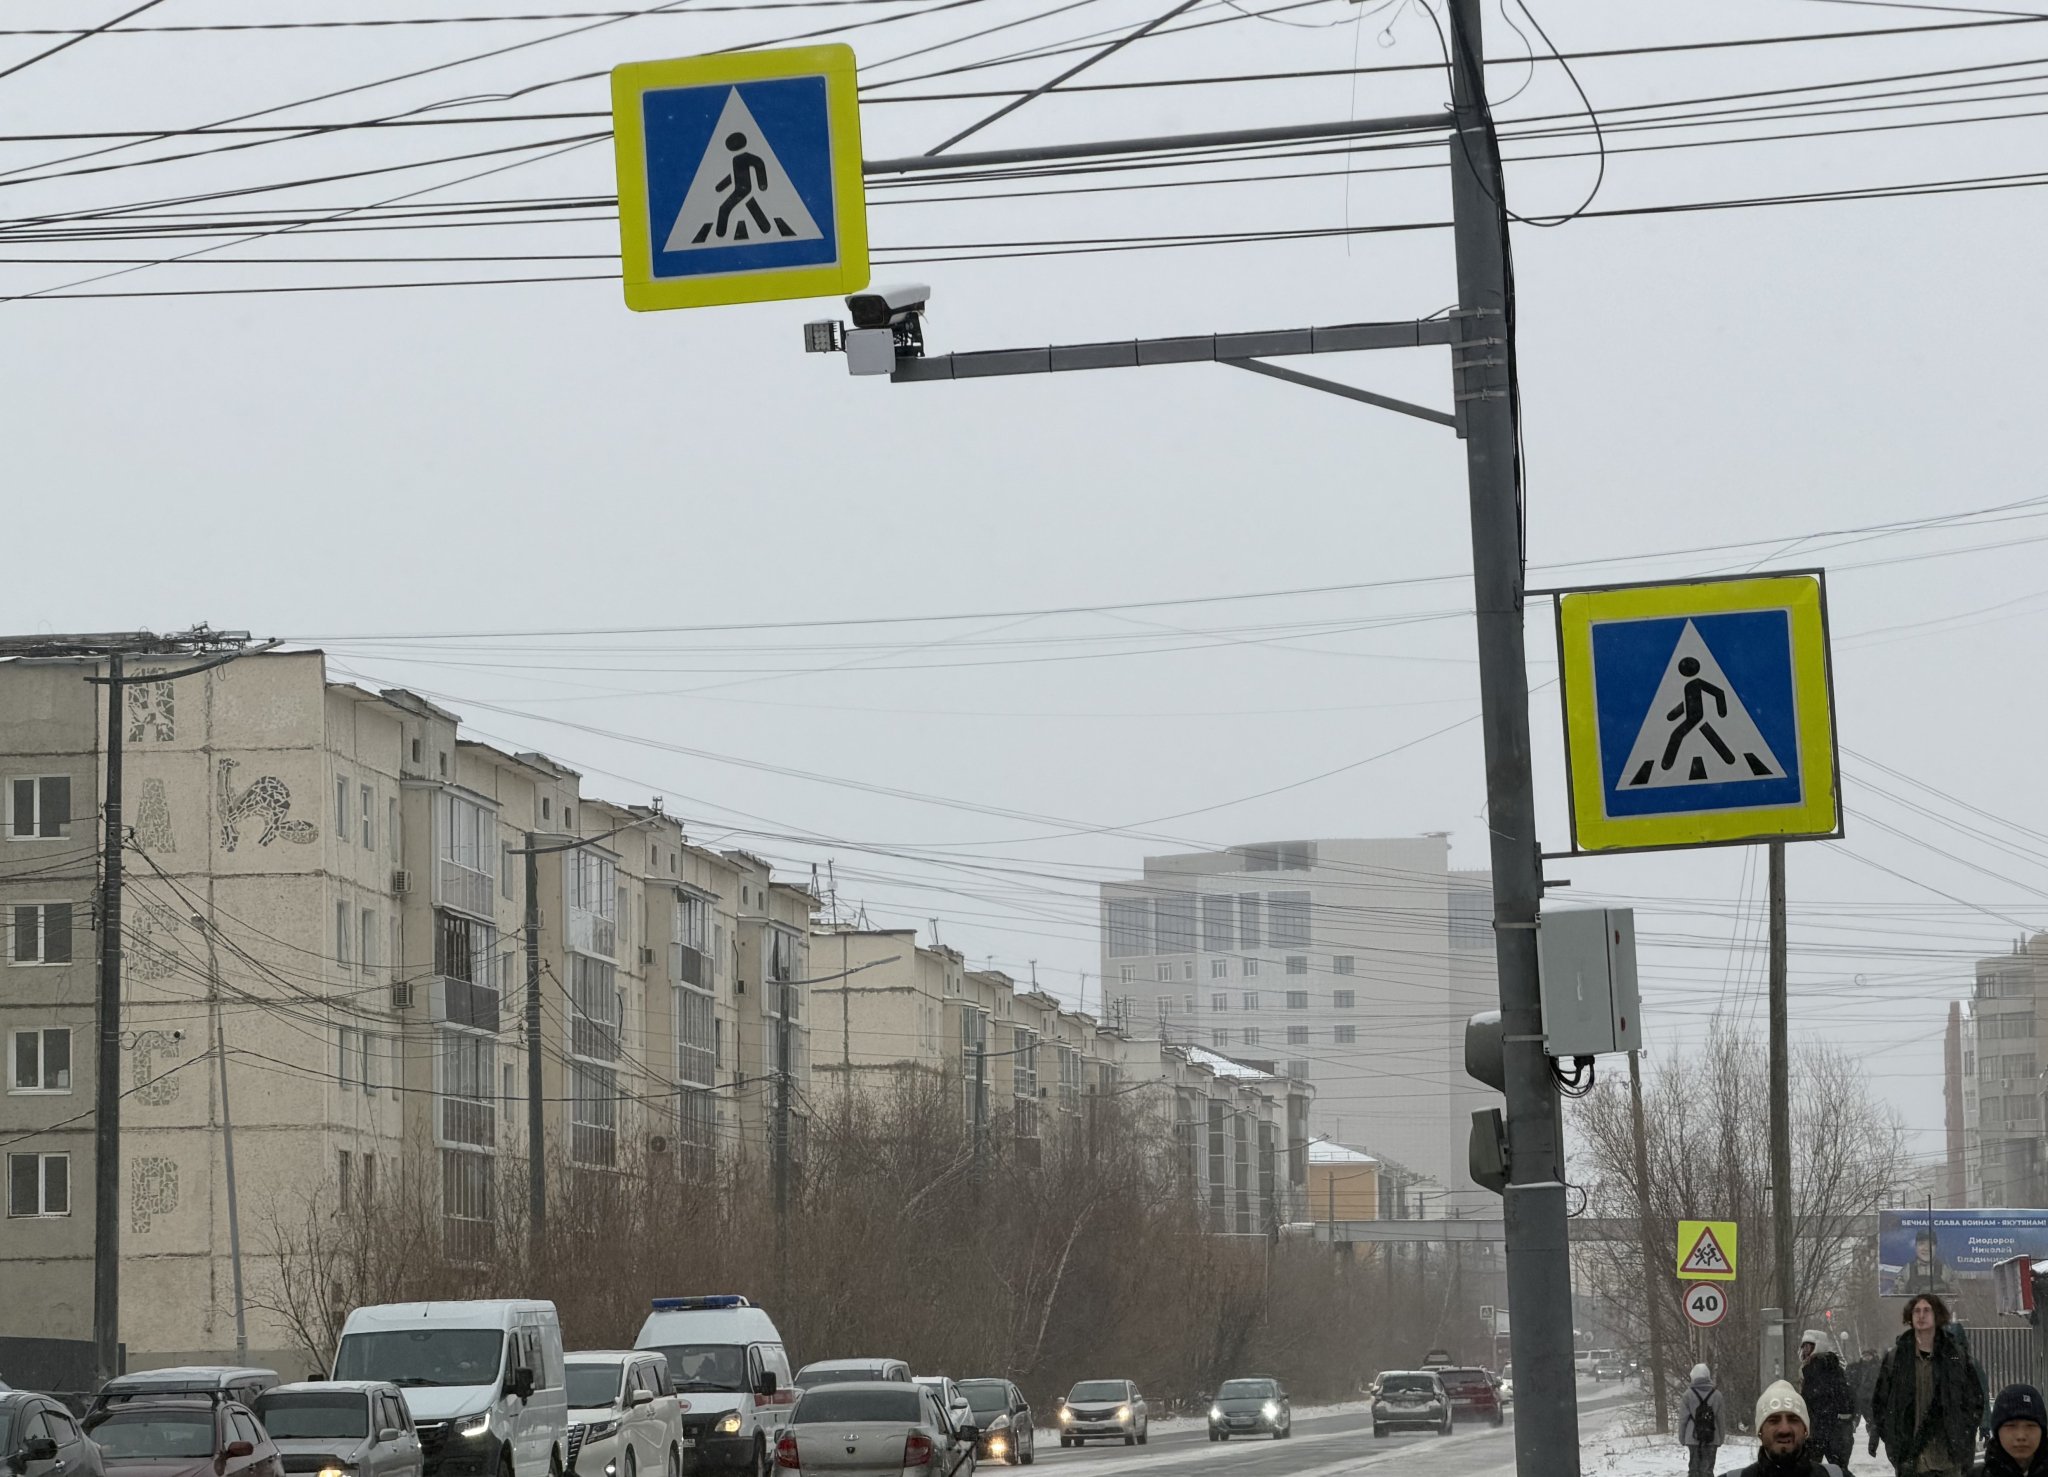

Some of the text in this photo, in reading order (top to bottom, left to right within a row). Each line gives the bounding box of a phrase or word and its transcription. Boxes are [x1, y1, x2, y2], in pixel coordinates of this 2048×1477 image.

[1968, 1236, 2015, 1245] Диодоров
[1971, 1246, 2012, 1254] Николай
[1692, 1296, 1718, 1312] 40
